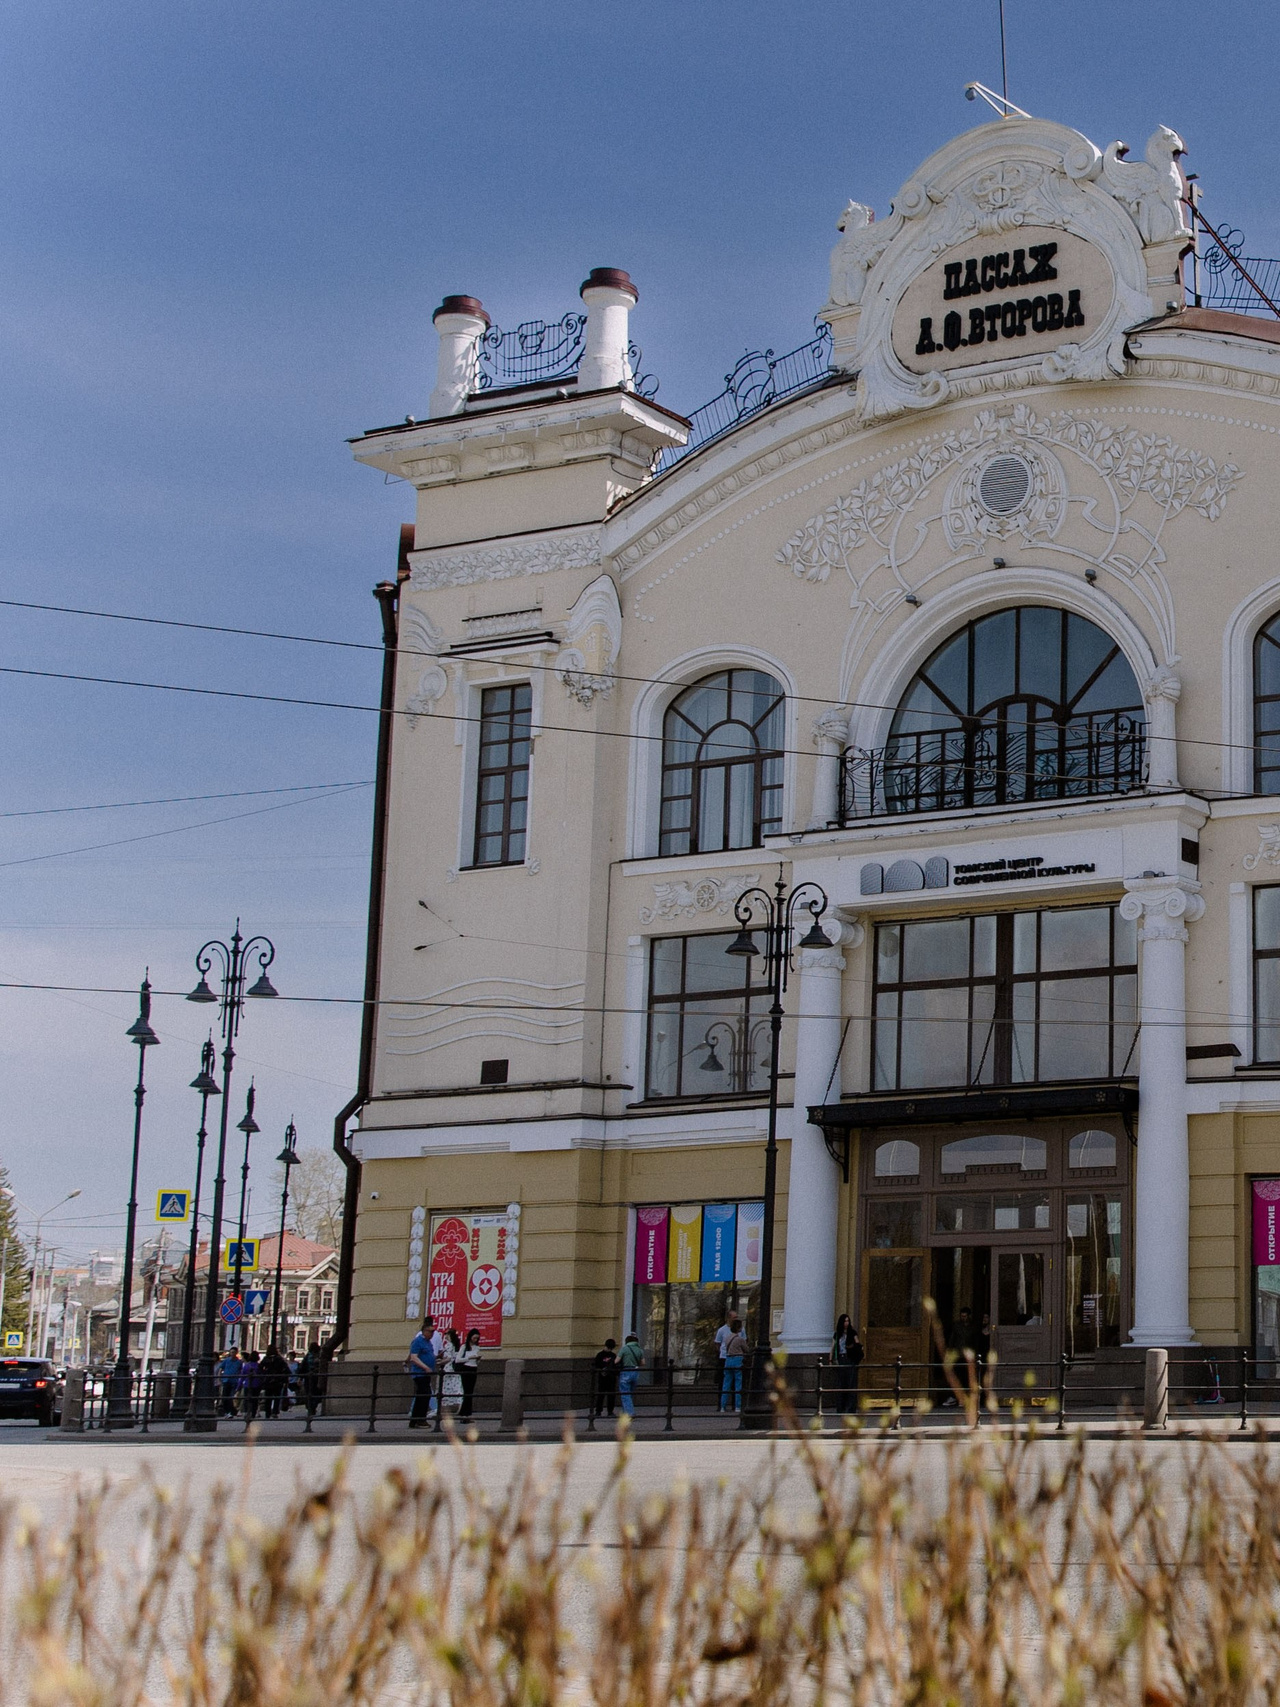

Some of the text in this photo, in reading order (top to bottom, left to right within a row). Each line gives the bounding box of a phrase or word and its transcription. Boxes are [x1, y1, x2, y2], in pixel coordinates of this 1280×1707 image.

[943, 242, 1058, 300] ПАССАЖ
[953, 857, 1044, 875] ТОМСКИЙ ЦЕНТР
[953, 863, 1096, 886] СОВРЕМЕННОЙ КУЛЬТУРЫ
[1267, 1205, 1275, 1261] ОТКРЫТИЕ
[646, 1230, 655, 1280] ОТКРЫТИЕ
[431, 1272, 455, 1286] ТРА
[430, 1286, 448, 1302] ДИ
[430, 1301, 454, 1317] ЦИЯ
